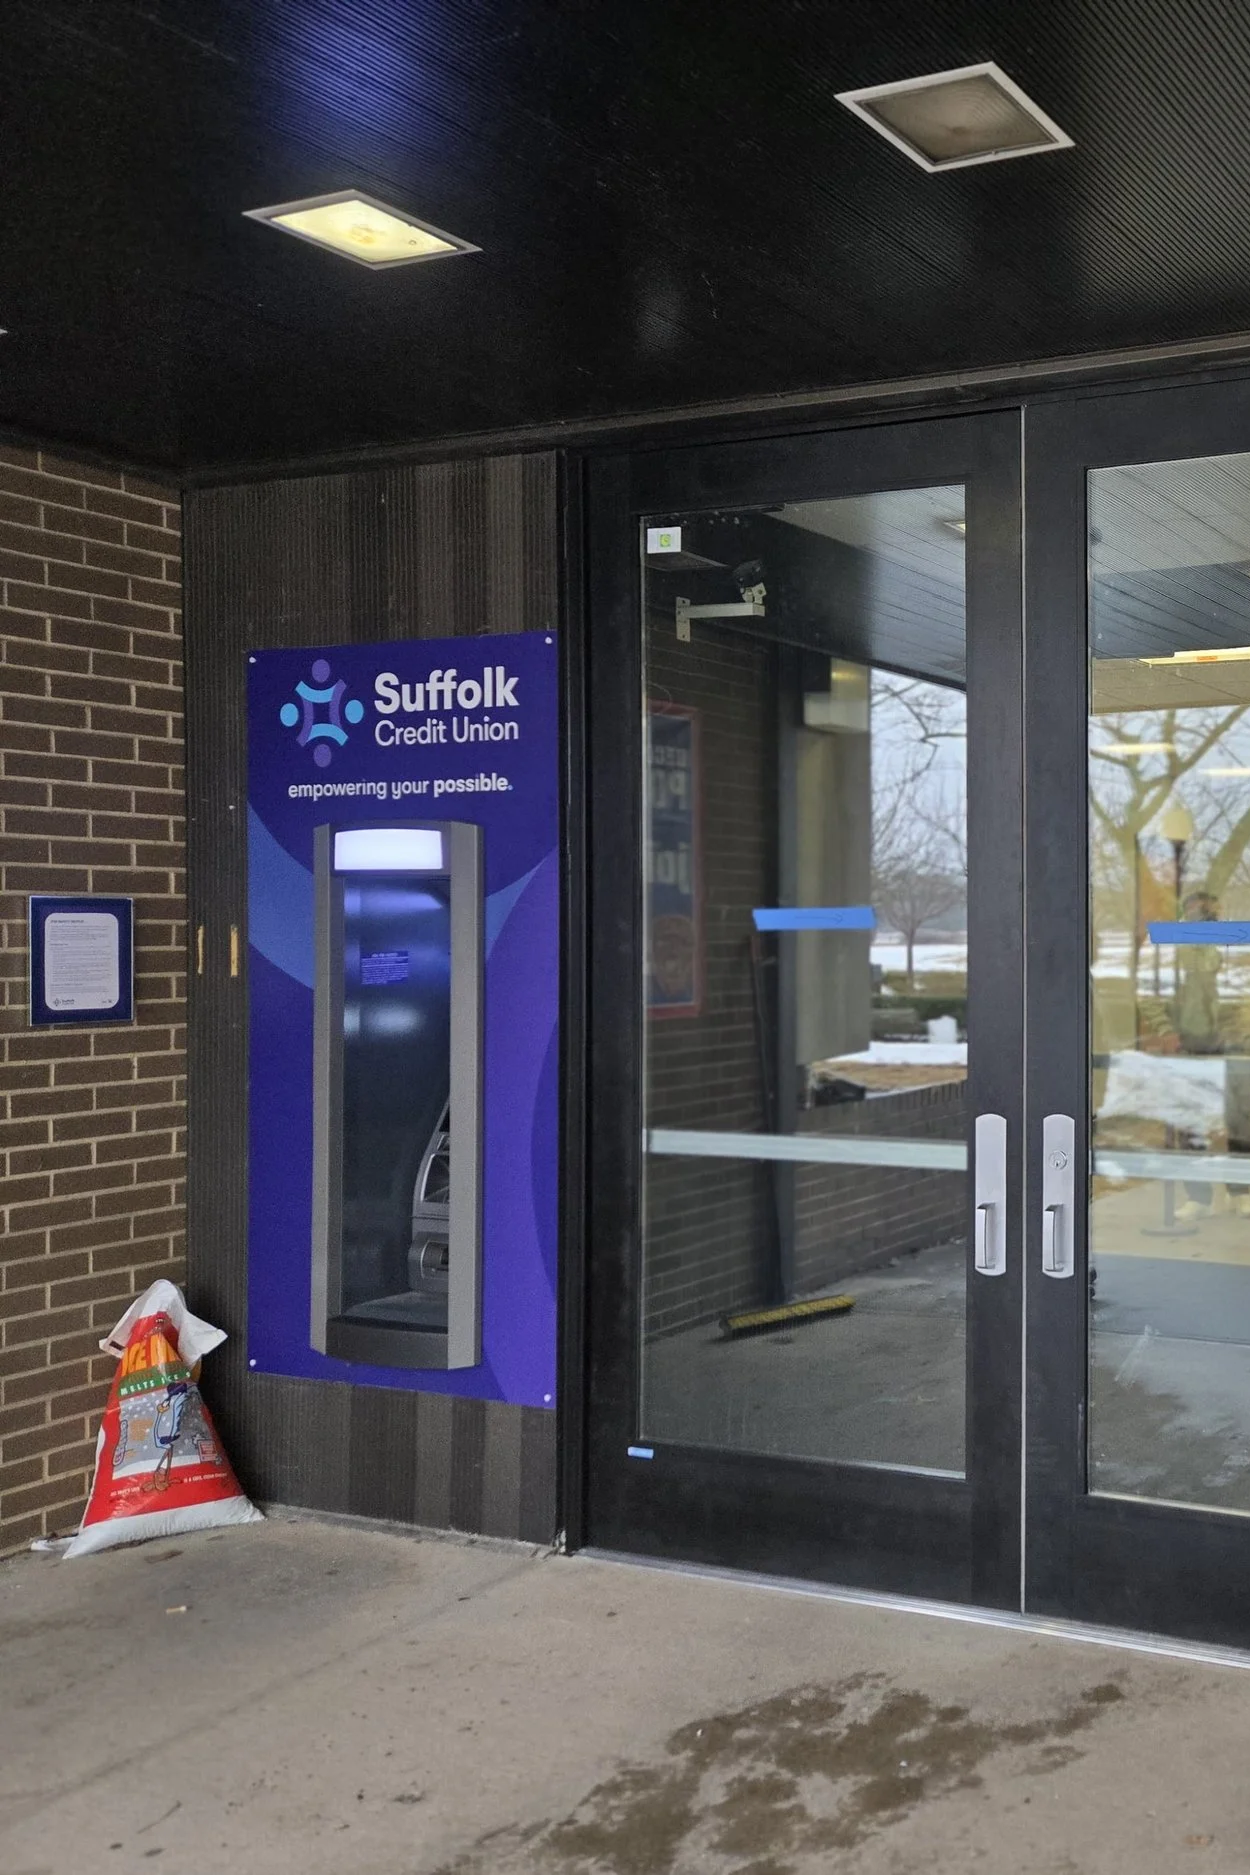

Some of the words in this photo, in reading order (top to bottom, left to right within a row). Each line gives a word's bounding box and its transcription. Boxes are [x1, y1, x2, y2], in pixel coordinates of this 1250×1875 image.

[374, 666, 520, 714] Suffolk
[374, 718, 447, 746] Credit
[452, 715, 519, 743] Union
[288, 779, 388, 801] empowering
[391, 780, 430, 800] your
[120, 1379, 155, 1395] MELTS
